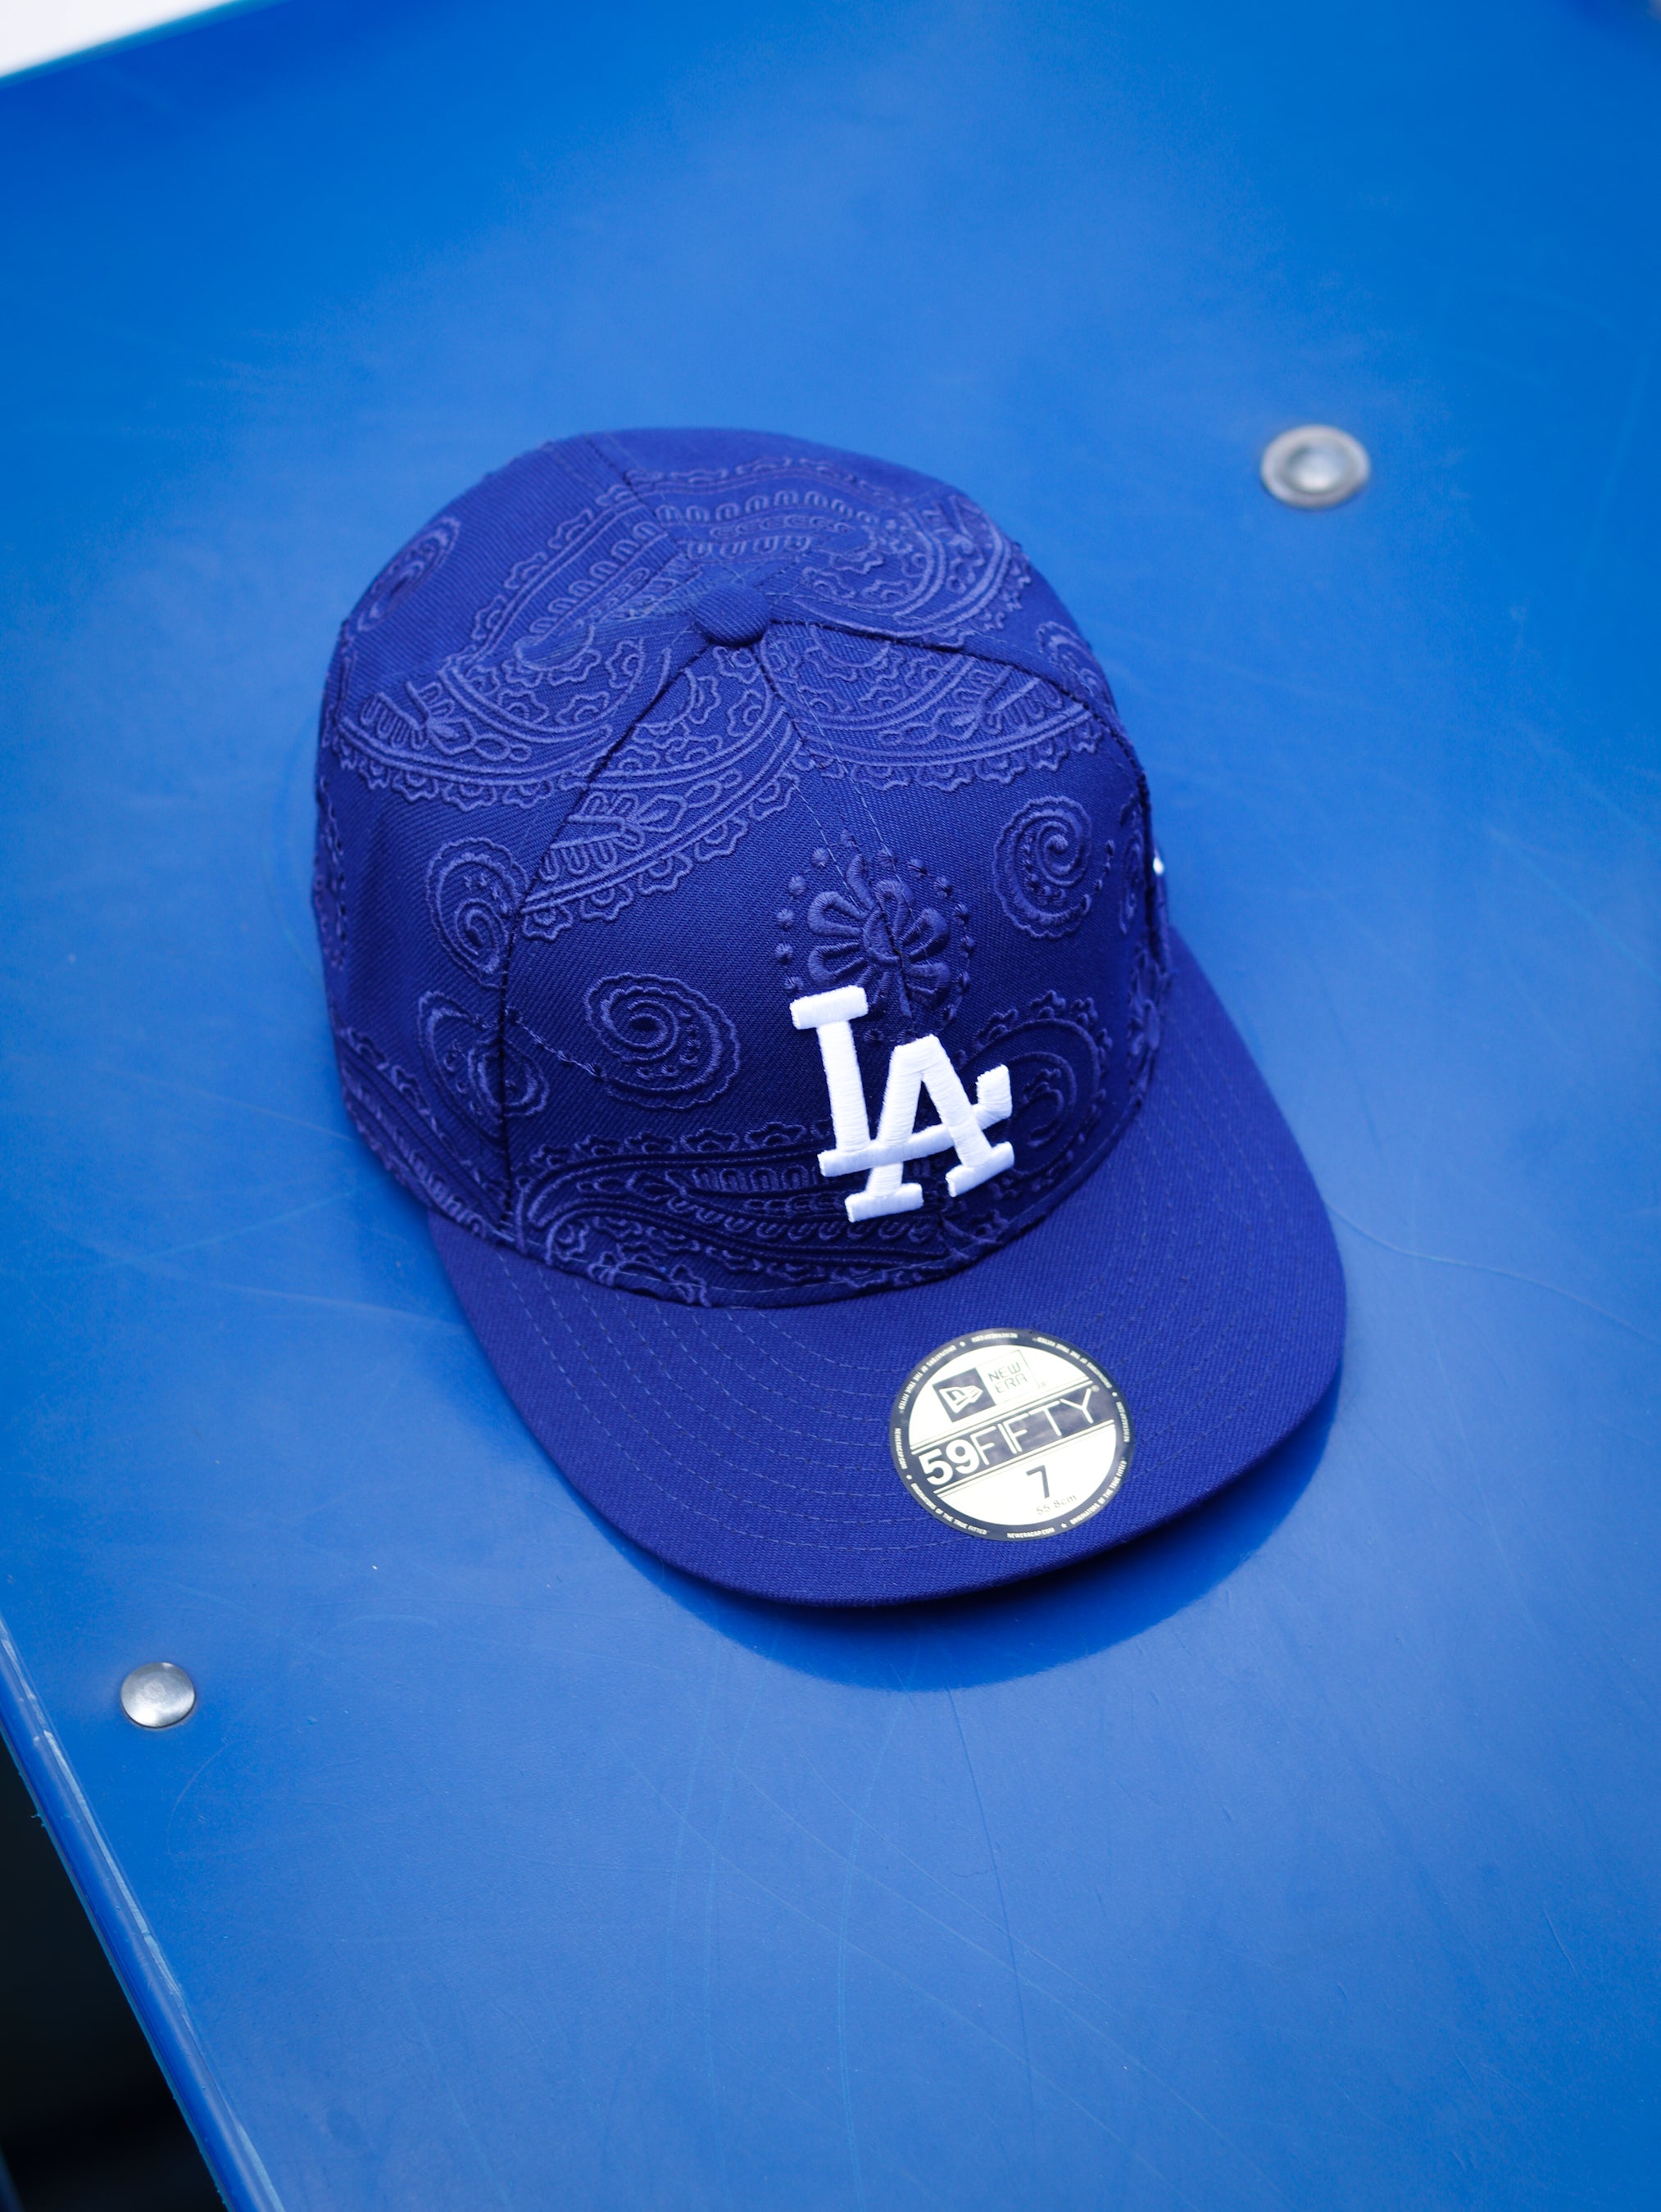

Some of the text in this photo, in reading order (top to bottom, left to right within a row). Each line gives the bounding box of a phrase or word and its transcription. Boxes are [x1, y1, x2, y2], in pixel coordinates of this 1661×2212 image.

[790, 985, 1015, 1222] LA
[912, 1371, 924, 1382] THE
[987, 1362, 1021, 1382] NEW
[905, 1380, 917, 1394] TRUE
[995, 1375, 1028, 1394] ERA
[918, 1388, 1093, 1485] 59FIFTY
[1025, 1464, 1051, 1499] 7
[1101, 1488, 1114, 1498] THE
[1109, 1475, 1121, 1489] TRUE
[1036, 1494, 1077, 1515] 558cm
